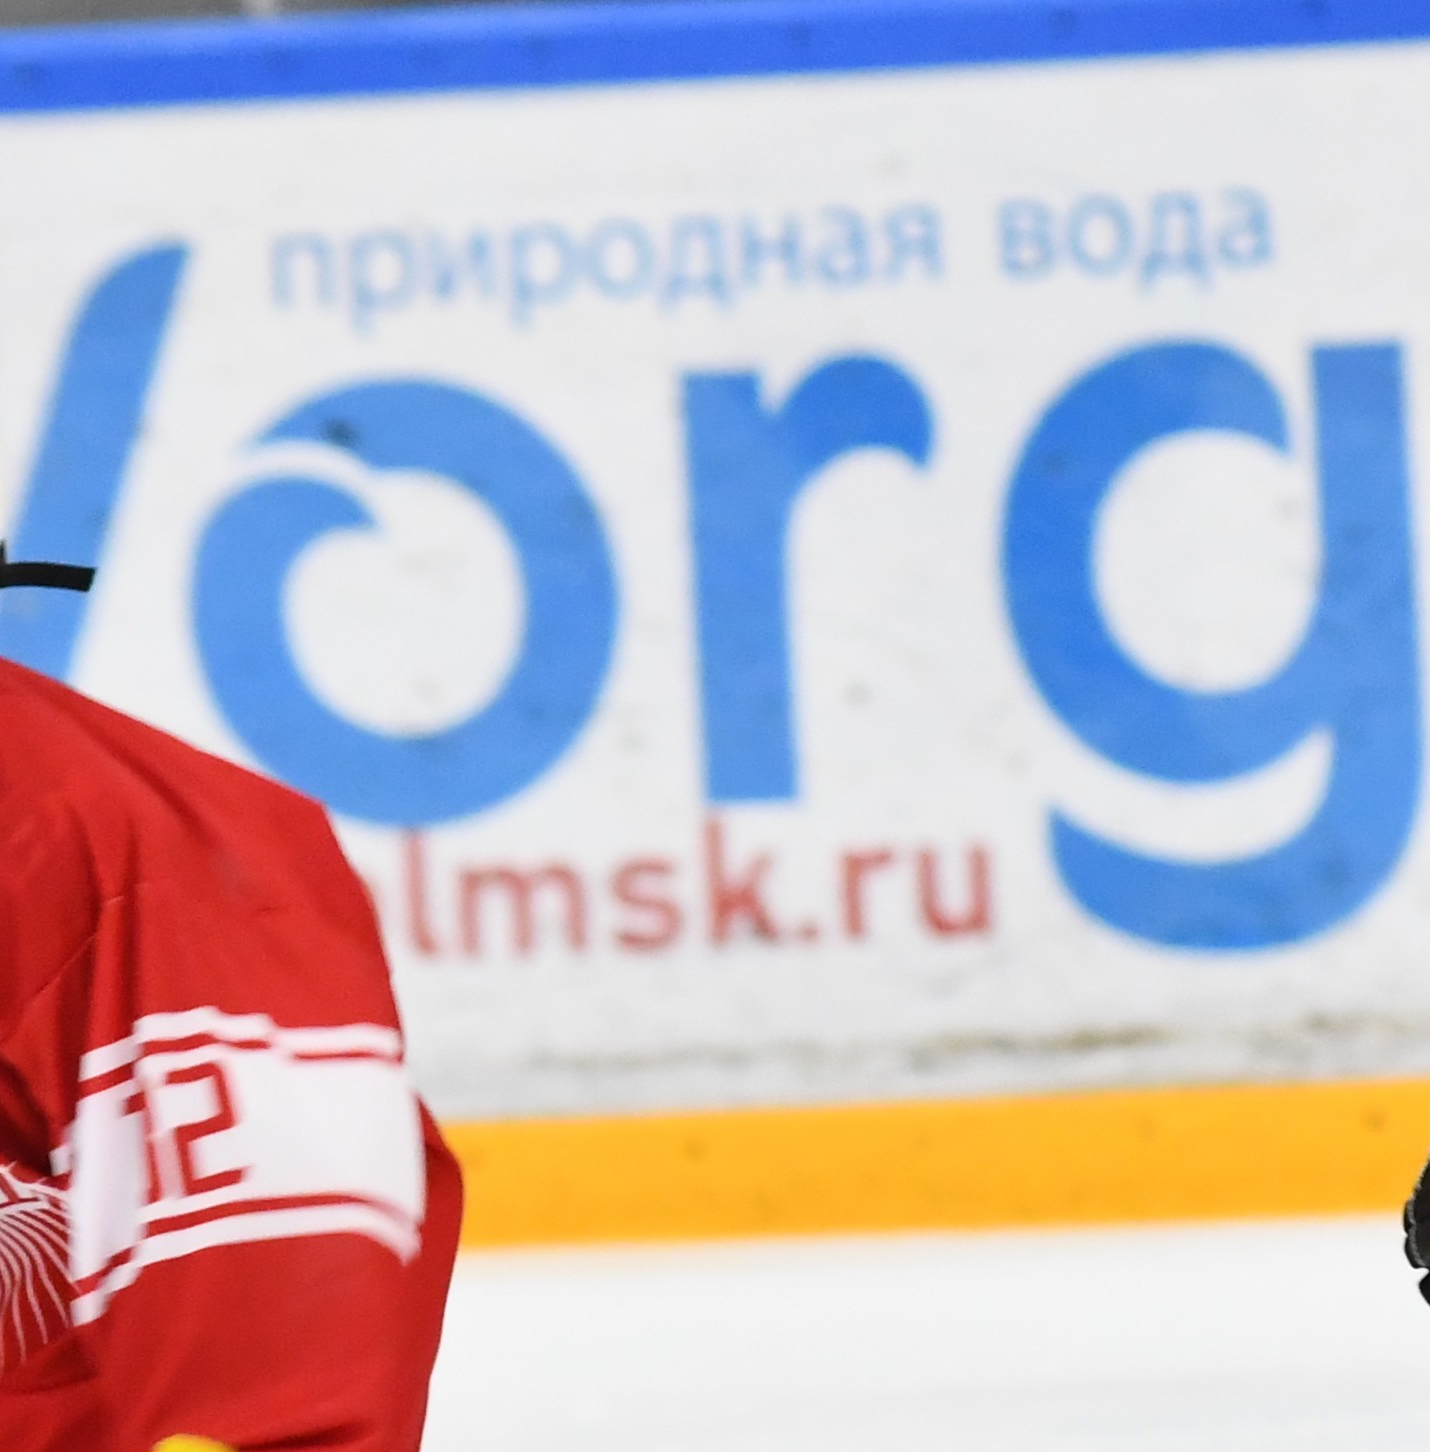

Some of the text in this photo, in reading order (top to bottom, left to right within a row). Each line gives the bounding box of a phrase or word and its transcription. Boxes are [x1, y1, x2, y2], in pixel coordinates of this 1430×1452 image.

[267, 182, 1276, 332] природная вода
[357, 820, 998, 962] lmsk.ru
